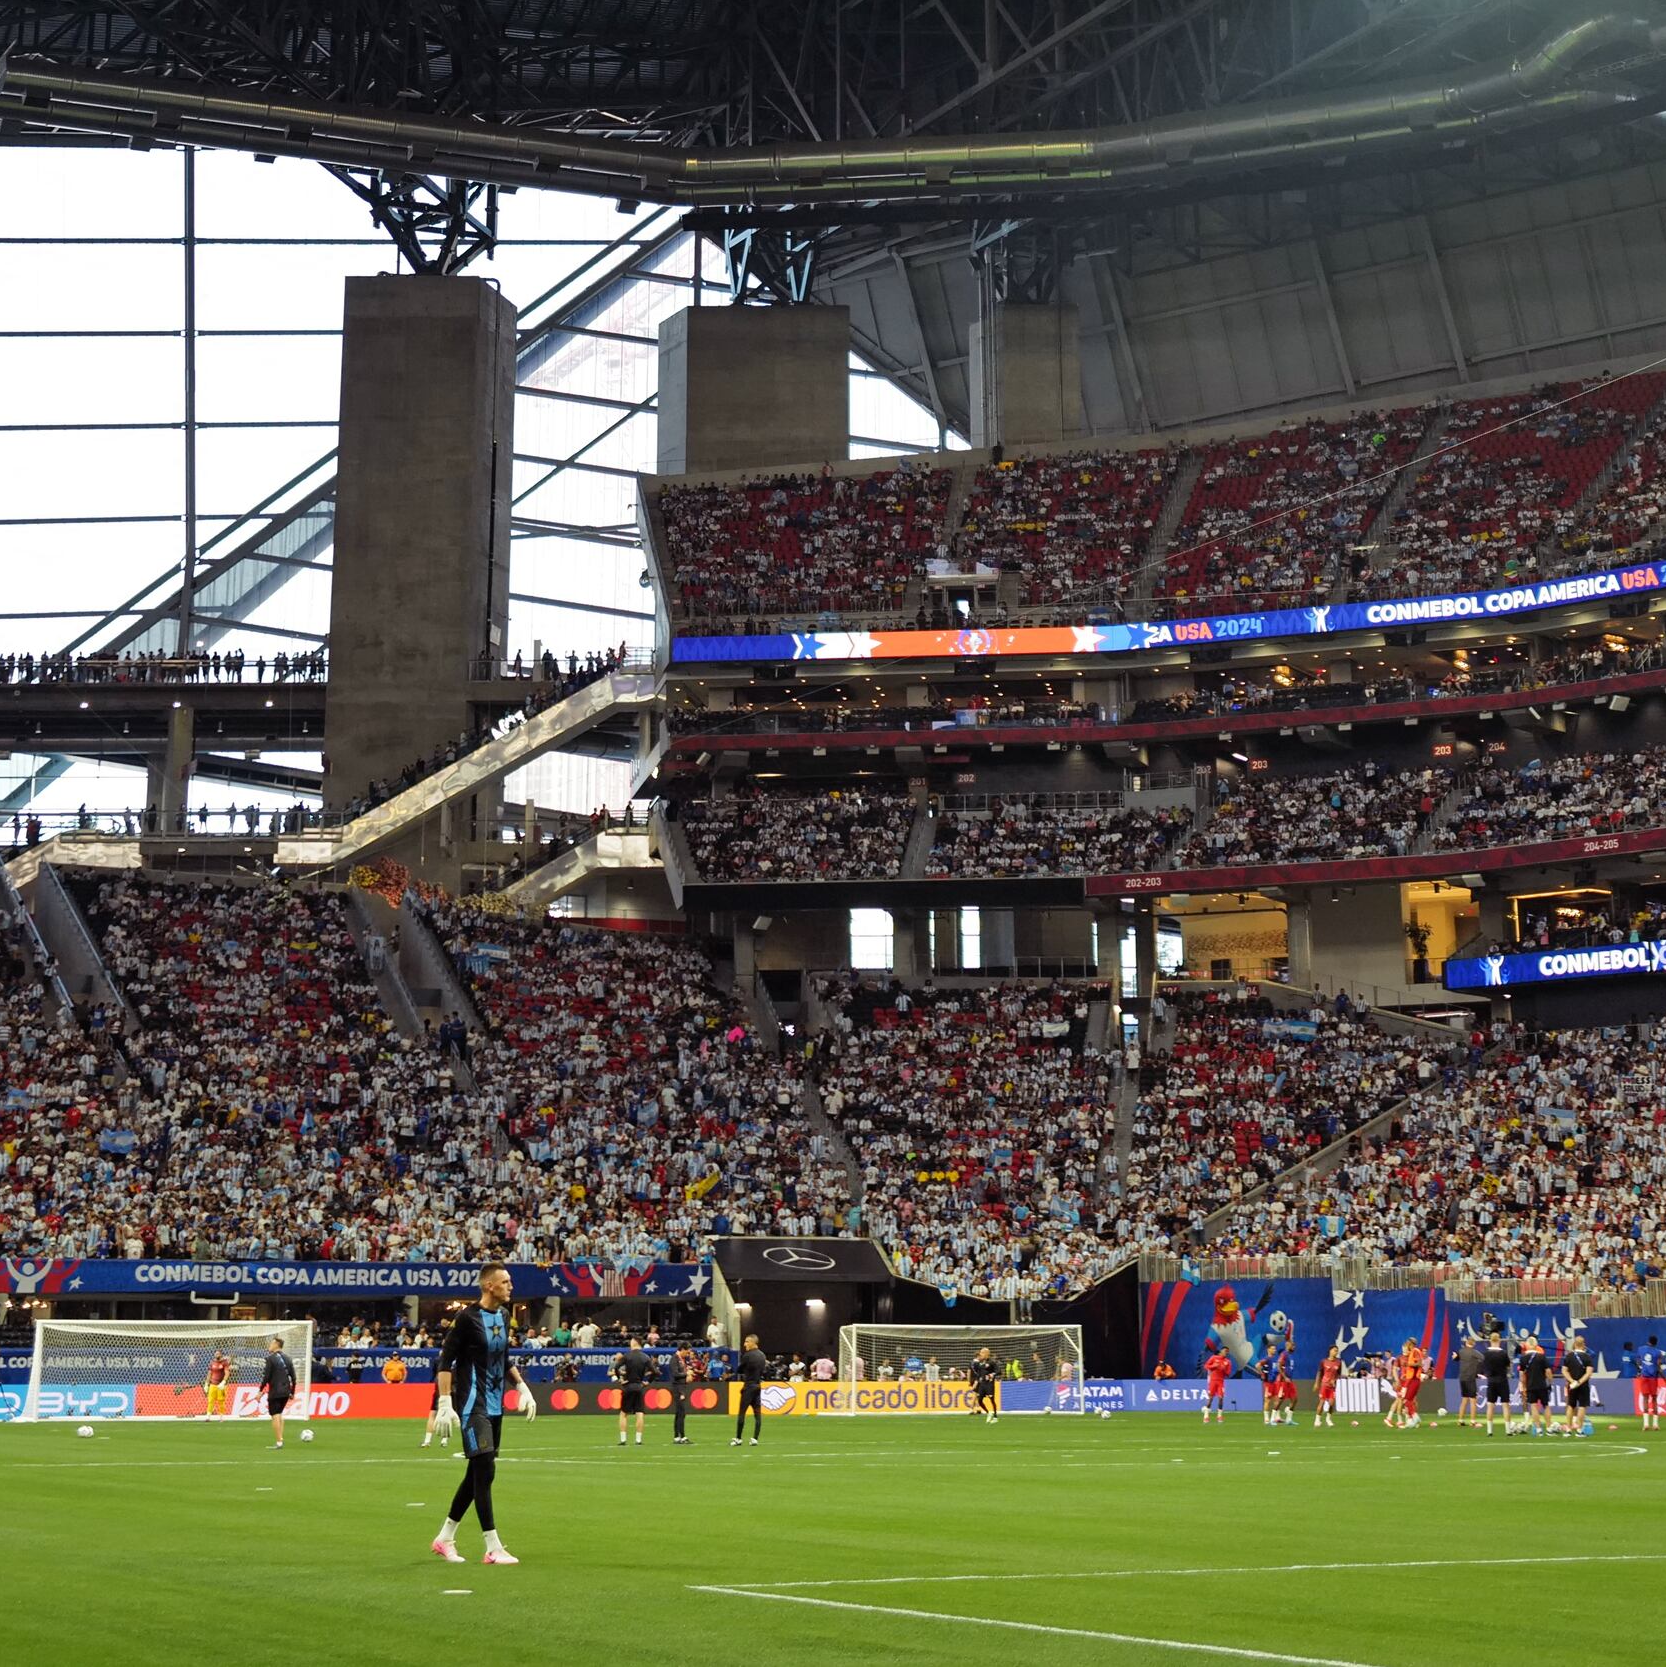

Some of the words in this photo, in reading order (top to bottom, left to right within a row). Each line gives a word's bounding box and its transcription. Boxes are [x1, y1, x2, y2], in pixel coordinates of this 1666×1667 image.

[1367, 595, 1484, 623] CONMEBOL
[1485, 589, 1537, 613] COPA
[1537, 574, 1621, 604] AMERICA
[1621, 567, 1660, 591] USA
[1174, 621, 1214, 641] USA
[1215, 617, 1263, 638] 2024
[1434, 745, 1452, 756] 203
[1252, 759, 1269, 770] 203
[958, 773, 976, 784] 202
[1583, 839, 1620, 853] 204-205
[1125, 877, 1162, 888] 202-203
[1539, 947, 1650, 976] CONMEBOL
[135, 1264, 254, 1284] CONMEBOL
[256, 1266, 312, 1285] COPA
[312, 1267, 403, 1287] AMERICA
[406, 1269, 445, 1288] USA
[447, 1269, 482, 1288] 202
[805, 1382, 918, 1412] mercado
[923, 1381, 980, 1410] libre
[1071, 1385, 1124, 1399] LATAM
[1164, 1389, 1211, 1401] DELTA
[1336, 1378, 1381, 1412] UMA
[37, 1391, 130, 1413] BYD
[1071, 1400, 1124, 1410] ARLINES
